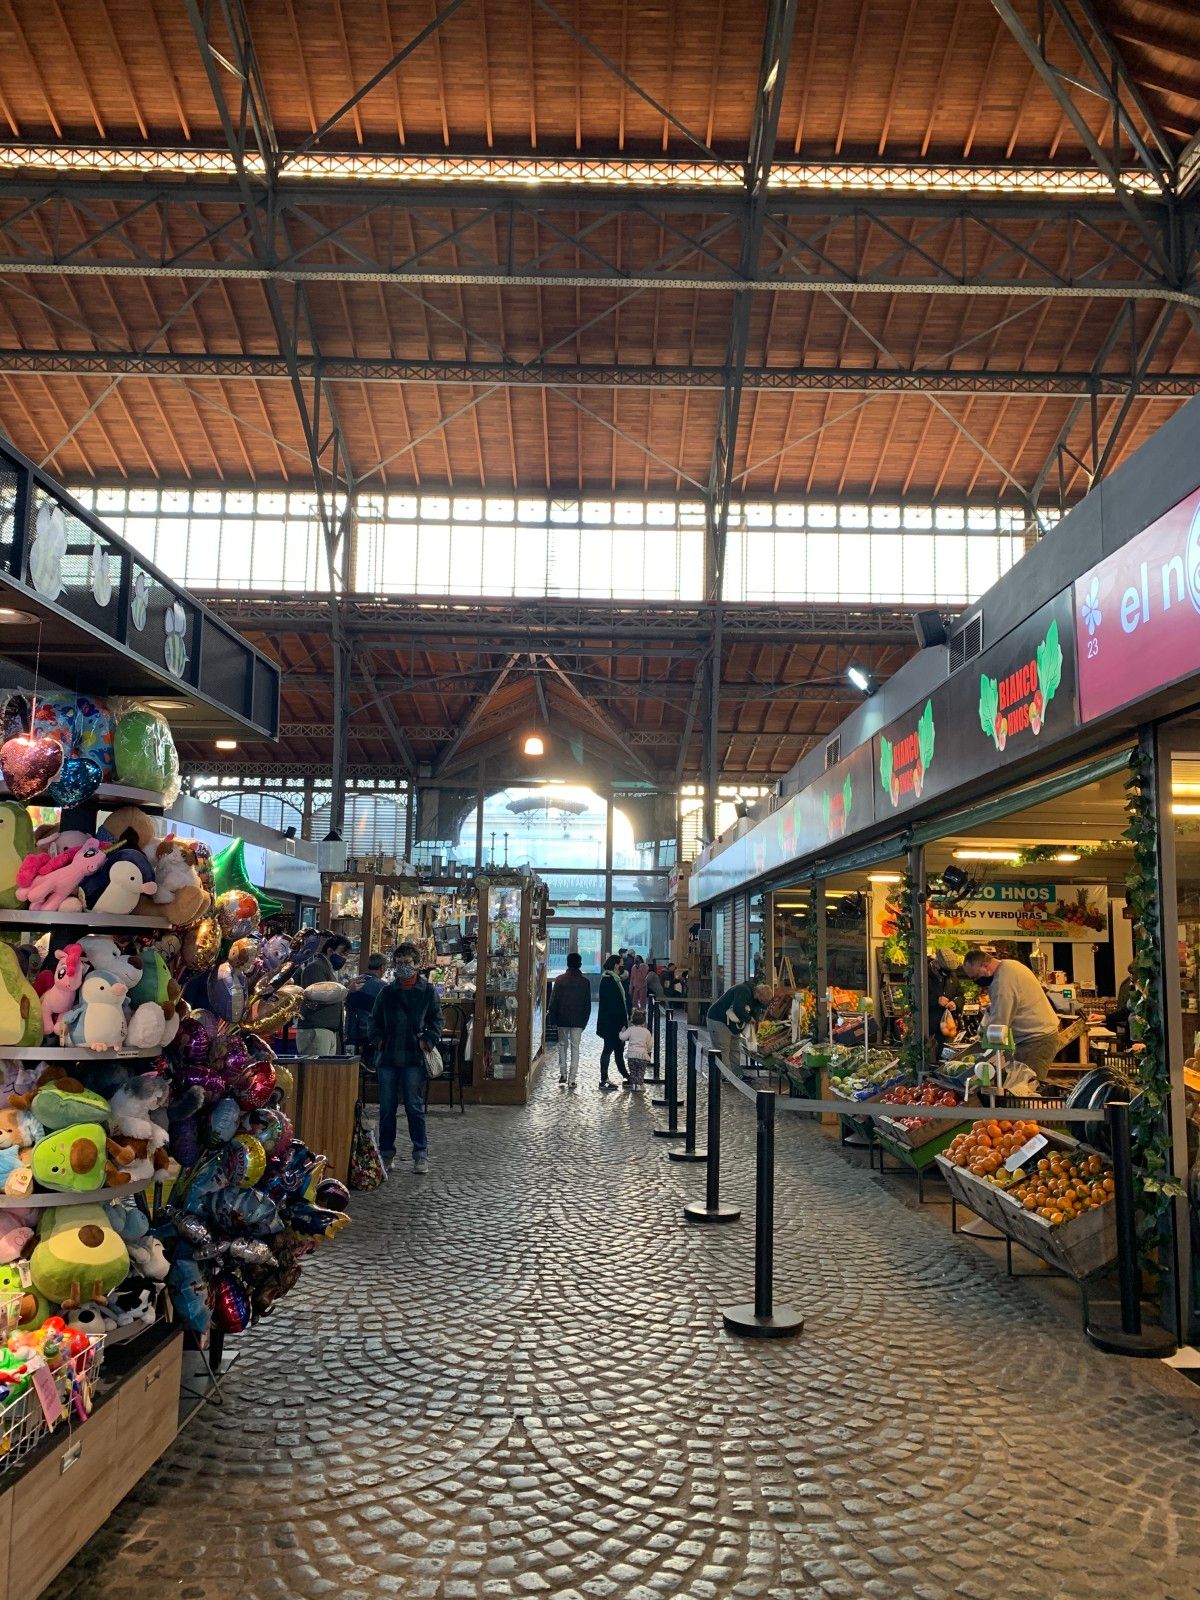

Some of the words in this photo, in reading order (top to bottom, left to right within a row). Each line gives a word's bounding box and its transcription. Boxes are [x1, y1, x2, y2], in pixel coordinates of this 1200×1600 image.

[1121, 562, 1150, 634] el
[1087, 638, 1099, 659] 23
[999, 659, 1038, 711] BIANCO
[1007, 704, 1030, 737] HNOS
[893, 730, 919, 772] BIANCO
[1001, 887, 1050, 900] HNOS
[938, 909, 977, 918] FRUTAS
[987, 911, 1043, 920] VERDURAS
